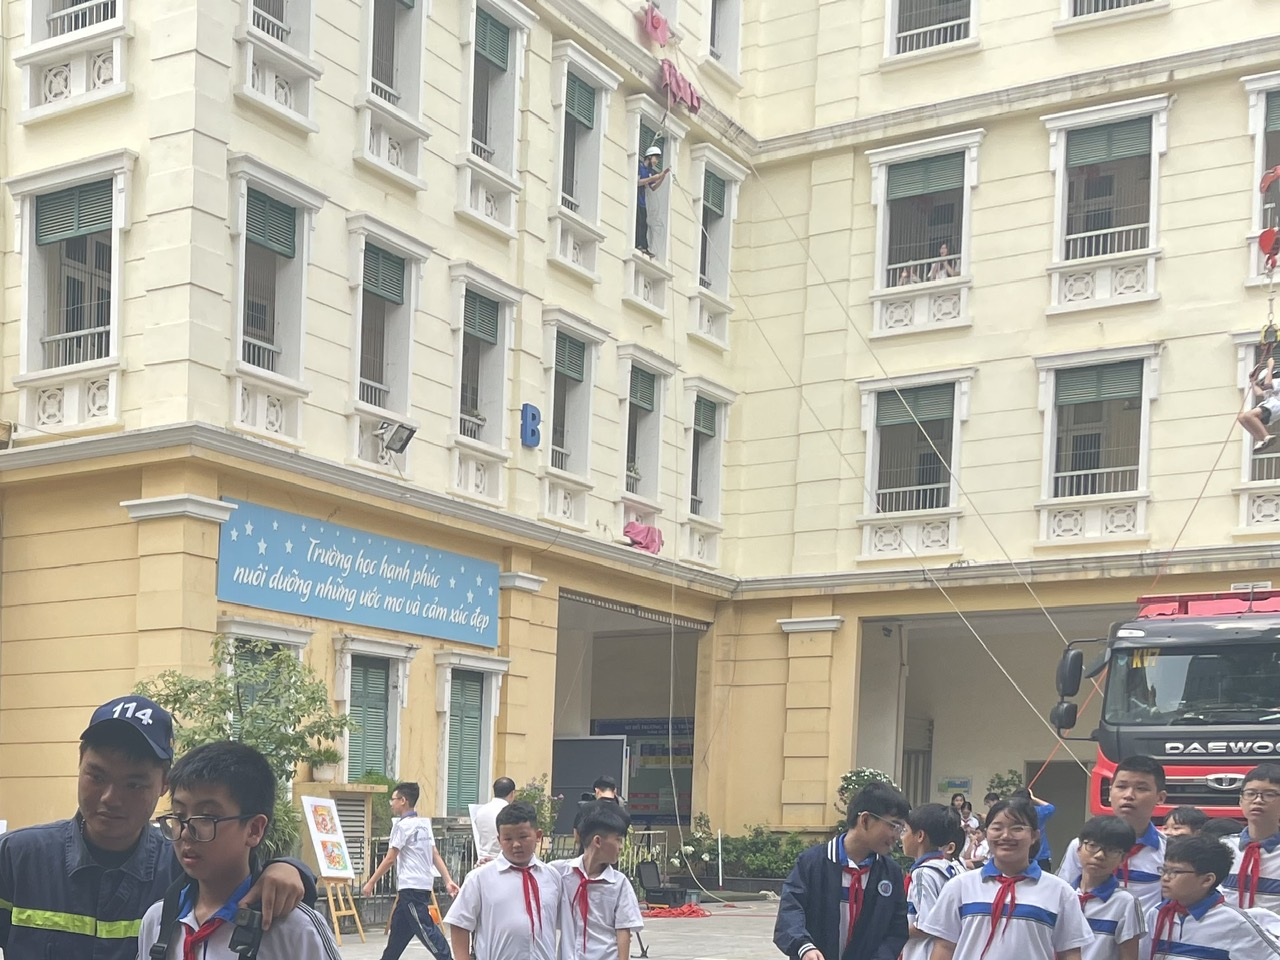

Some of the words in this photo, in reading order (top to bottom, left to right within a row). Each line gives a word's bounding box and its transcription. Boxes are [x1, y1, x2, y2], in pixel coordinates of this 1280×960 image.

[521, 403, 541, 448] B
[307, 537, 353, 577] Trường
[355, 549, 378, 578] học
[379, 555, 410, 584] hạnh
[411, 563, 441, 590] phúc
[233, 563, 269, 587] nuôi
[268, 566, 313, 603] dưỡng
[315, 576, 357, 611] những
[360, 586, 382, 609] ước
[383, 595, 406, 613] mơ
[405, 594, 421, 617] và
[422, 597, 448, 621] cảm
[448, 604, 469, 625] xúc
[470, 606, 490, 634] đẹp
[112, 702, 153, 726] 114
[1165, 741, 1280, 754] DAEWO
